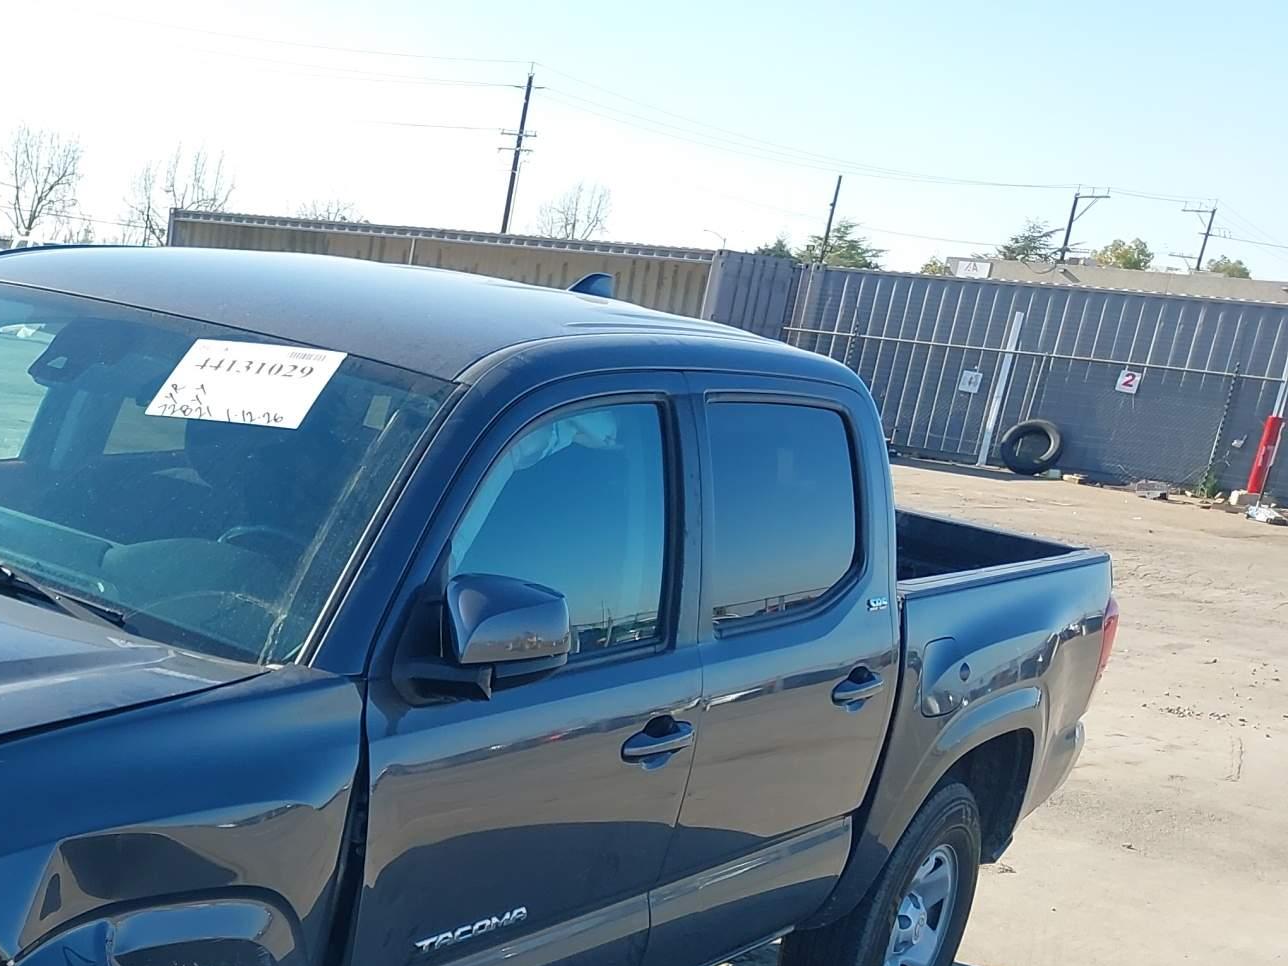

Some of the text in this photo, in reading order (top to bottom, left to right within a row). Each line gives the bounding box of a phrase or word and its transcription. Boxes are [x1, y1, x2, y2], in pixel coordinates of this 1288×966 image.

[195, 357, 315, 378] 44131029
[1121, 372, 1136, 388] 2
[415, 906, 528, 953] TACOMA
